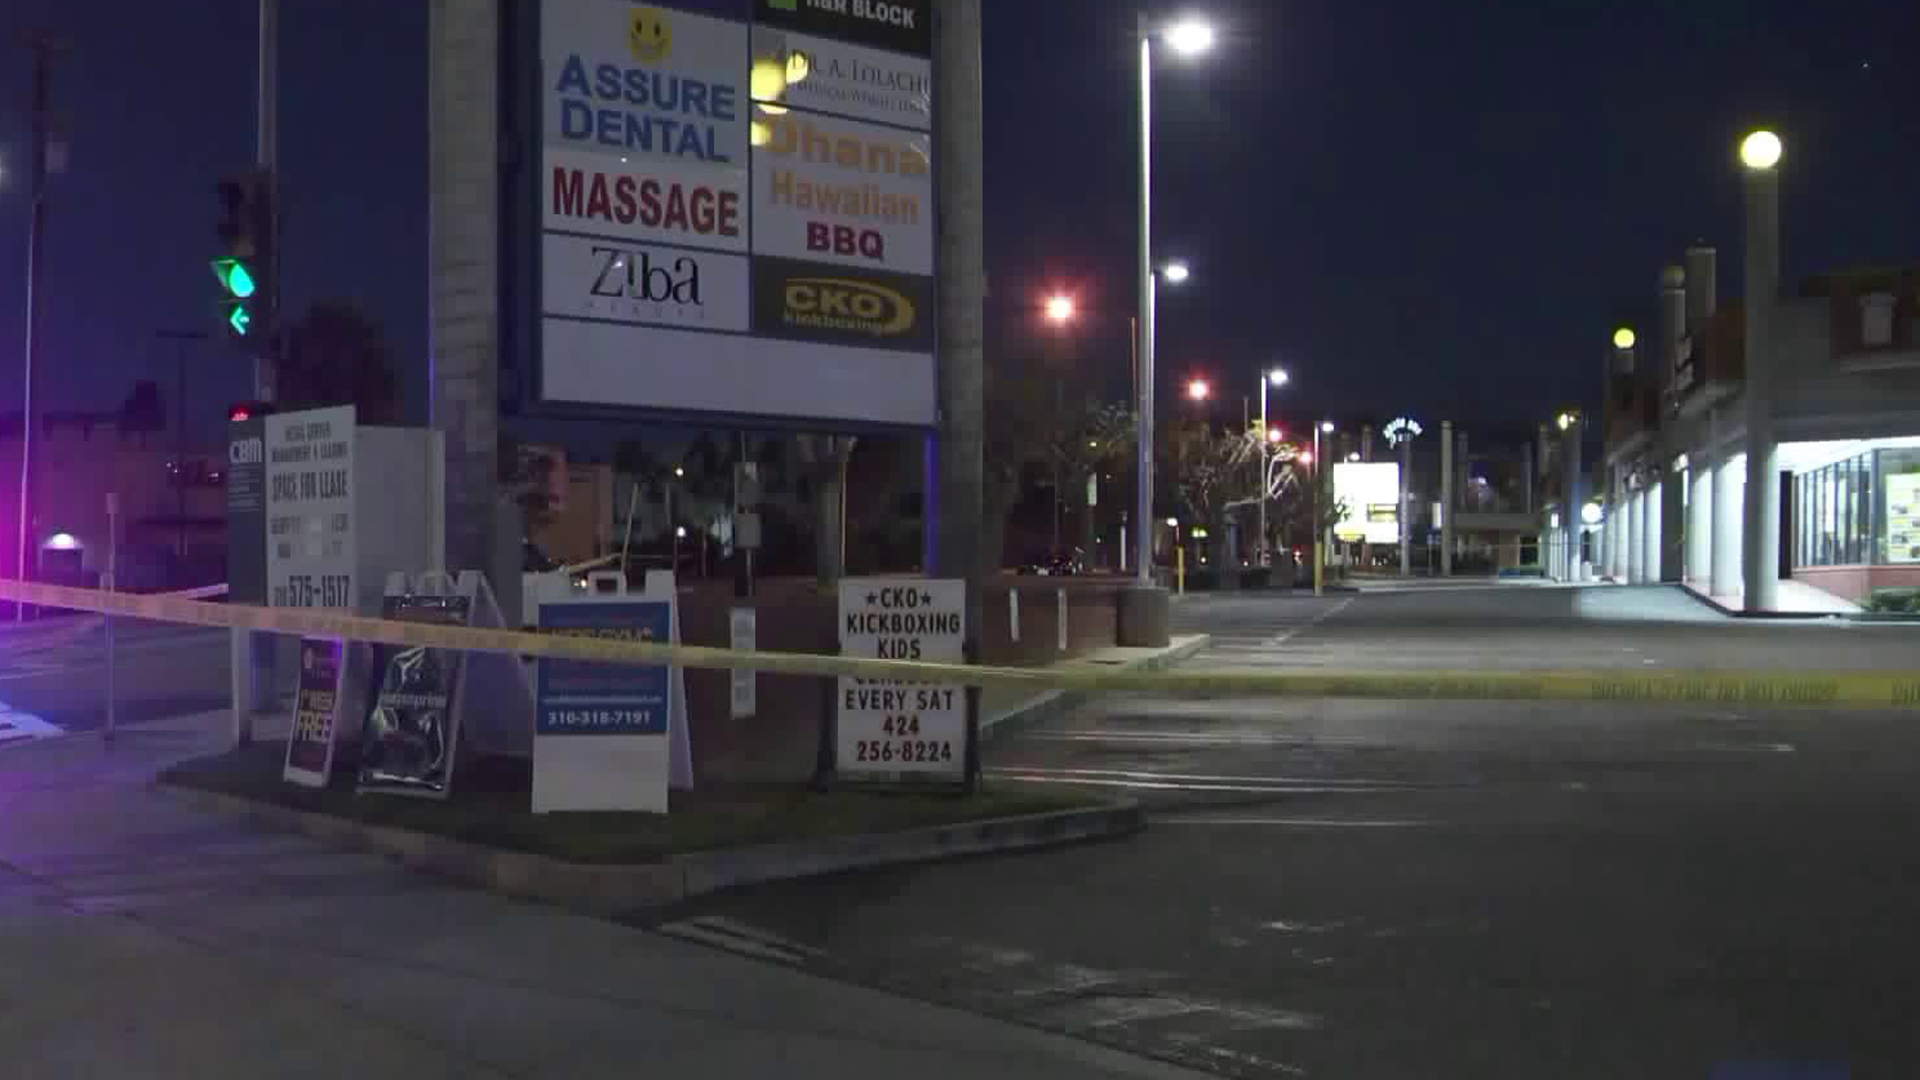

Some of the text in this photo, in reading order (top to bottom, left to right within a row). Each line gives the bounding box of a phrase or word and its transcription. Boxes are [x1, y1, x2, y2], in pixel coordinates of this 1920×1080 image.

[851, 0, 916, 29] BLOCK
[555, 54, 737, 122] ASSURE
[559, 97, 732, 163] DENTAL
[553, 166, 740, 237] MASSAGE
[806, 221, 885, 263] BBQ
[785, 285, 882, 318] CKO
[319, 467, 348, 500] LEASE
[880, 587, 918, 608] CKO
[847, 613, 961, 634] KICKBOXING
[878, 638, 921, 659] KIDS
[845, 688, 953, 711] EVERY SAT
[297, 710, 334, 743] FREE
[548, 709, 651, 728] 310-318-7191
[882, 715, 920, 736] 424
[857, 740, 952, 762] 256-8224
